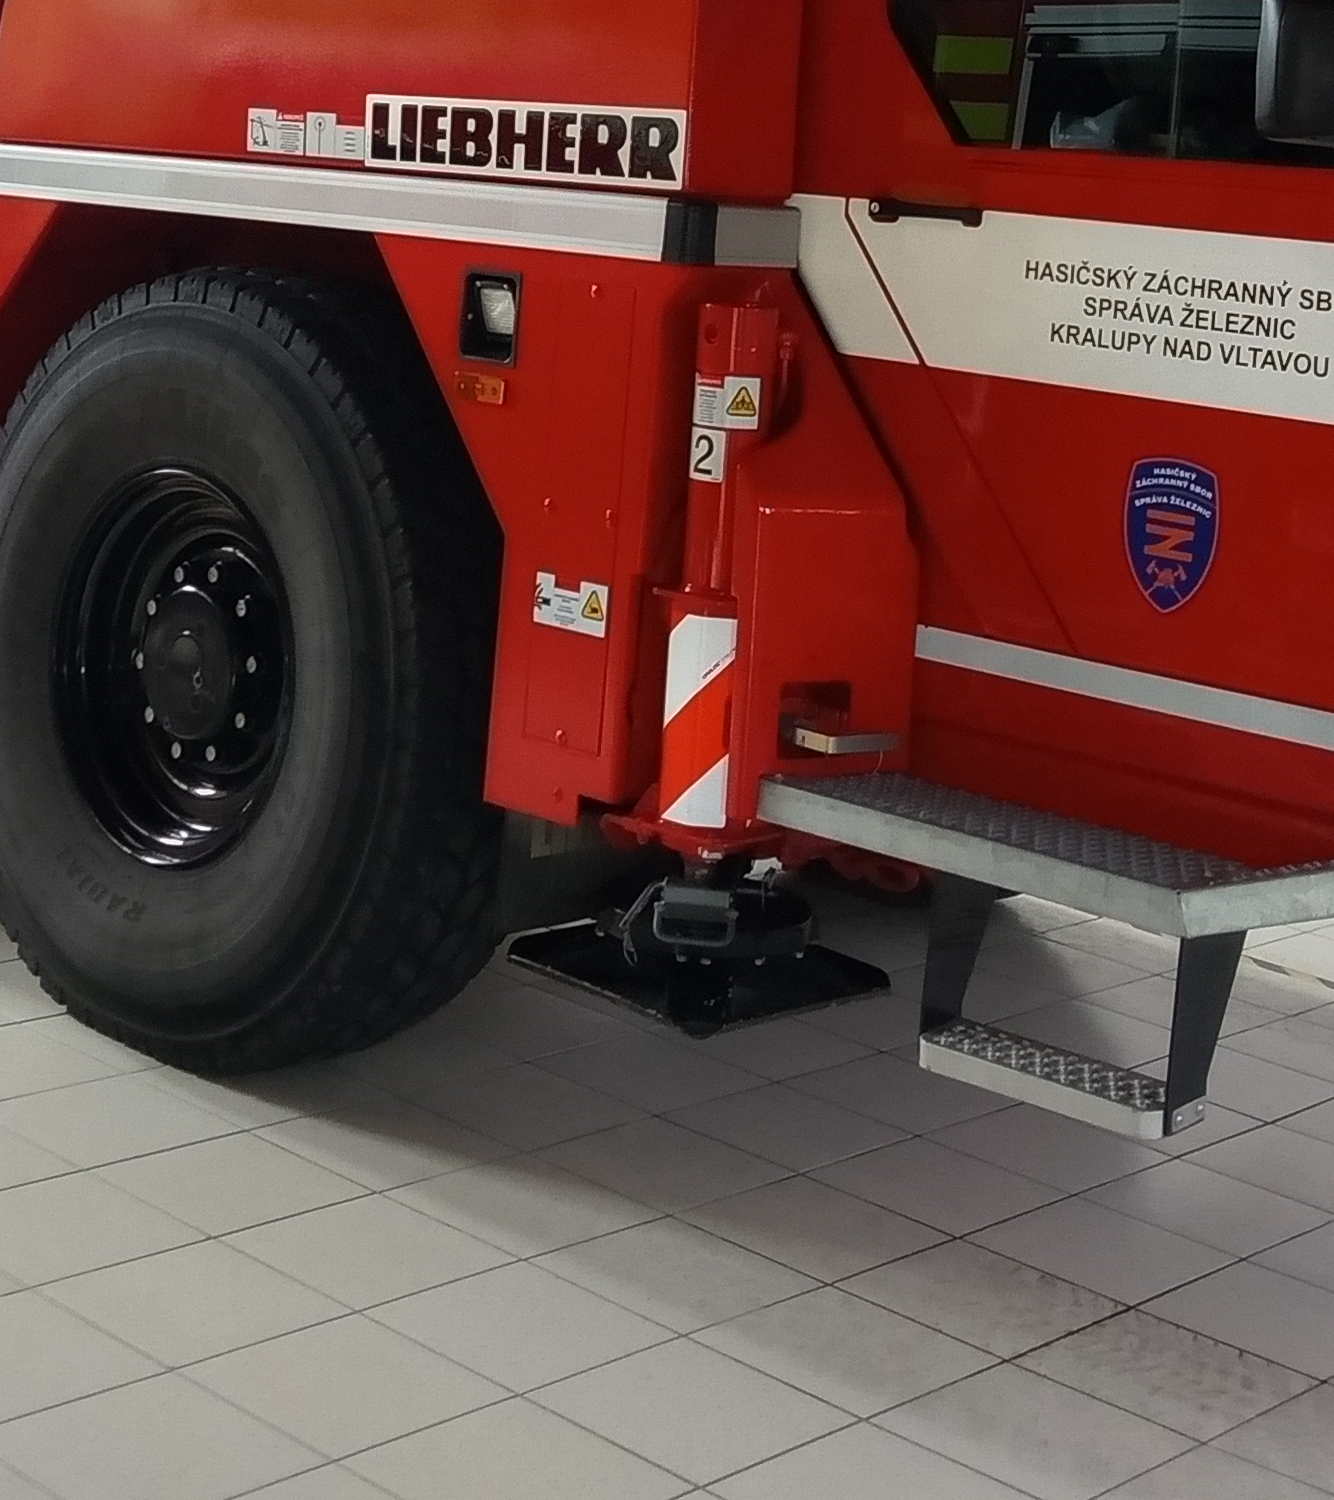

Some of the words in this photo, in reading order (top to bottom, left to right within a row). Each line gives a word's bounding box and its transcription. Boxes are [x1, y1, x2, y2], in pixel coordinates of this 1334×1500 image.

[370, 102, 681, 182] LIEBHERR
[1024, 259, 1137, 291] HASIČSKÝ
[1142, 269, 1292, 308] ZÁCHRANNÝ
[1083, 296, 1173, 325] SPRÁVA
[1179, 304, 1296, 341] ŽELEZNIC
[1050, 323, 1157, 356] KRALUPY
[1163, 337, 1212, 362] NAD
[1219, 343, 1330, 378] VLTAVOU
[693, 434, 714, 476] 2
[1153, 467, 1197, 480] HASIČSKÝ
[1134, 494, 1168, 507] SPRÁVA
[1169, 495, 1212, 519] ŽELEZNIC
[1135, 476, 1189, 489] ZÁCHRANNÝ
[1189, 483, 1213, 500] SBOR
